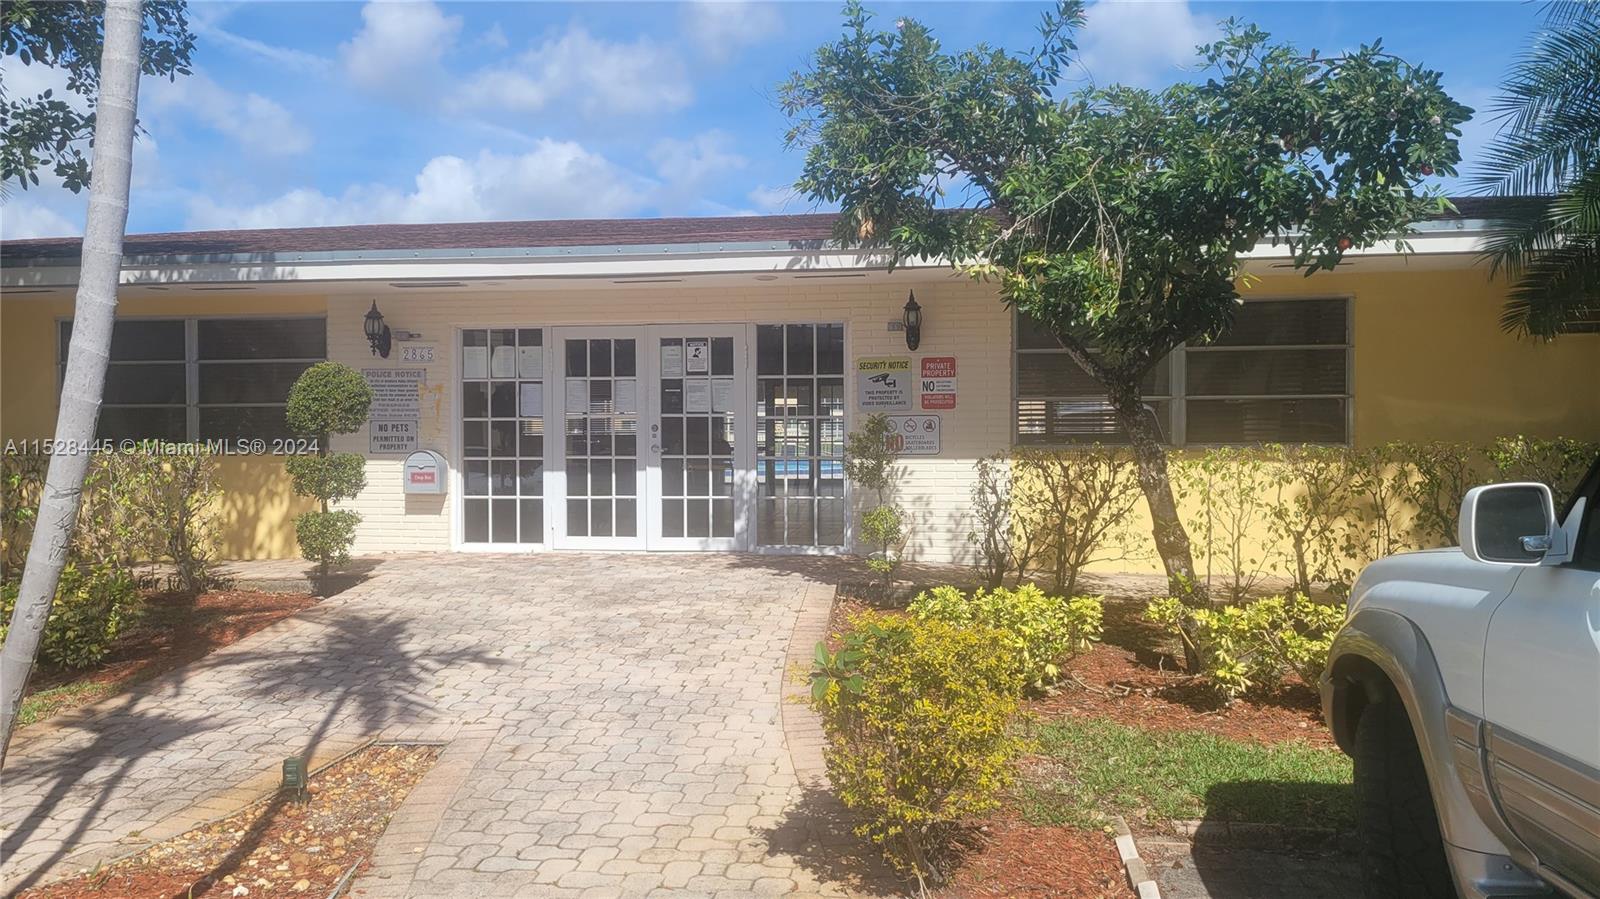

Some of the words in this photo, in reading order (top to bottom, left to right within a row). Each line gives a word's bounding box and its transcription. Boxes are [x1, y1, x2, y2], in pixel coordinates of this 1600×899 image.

[403, 349, 433, 360] 2865
[859, 360, 887, 370] SECURITY
[888, 360, 909, 369] NOTICE
[926, 362, 951, 370] PRIVATE
[922, 381, 935, 392] NO
[378, 424, 388, 432] NO
[391, 424, 409, 432] PETS
